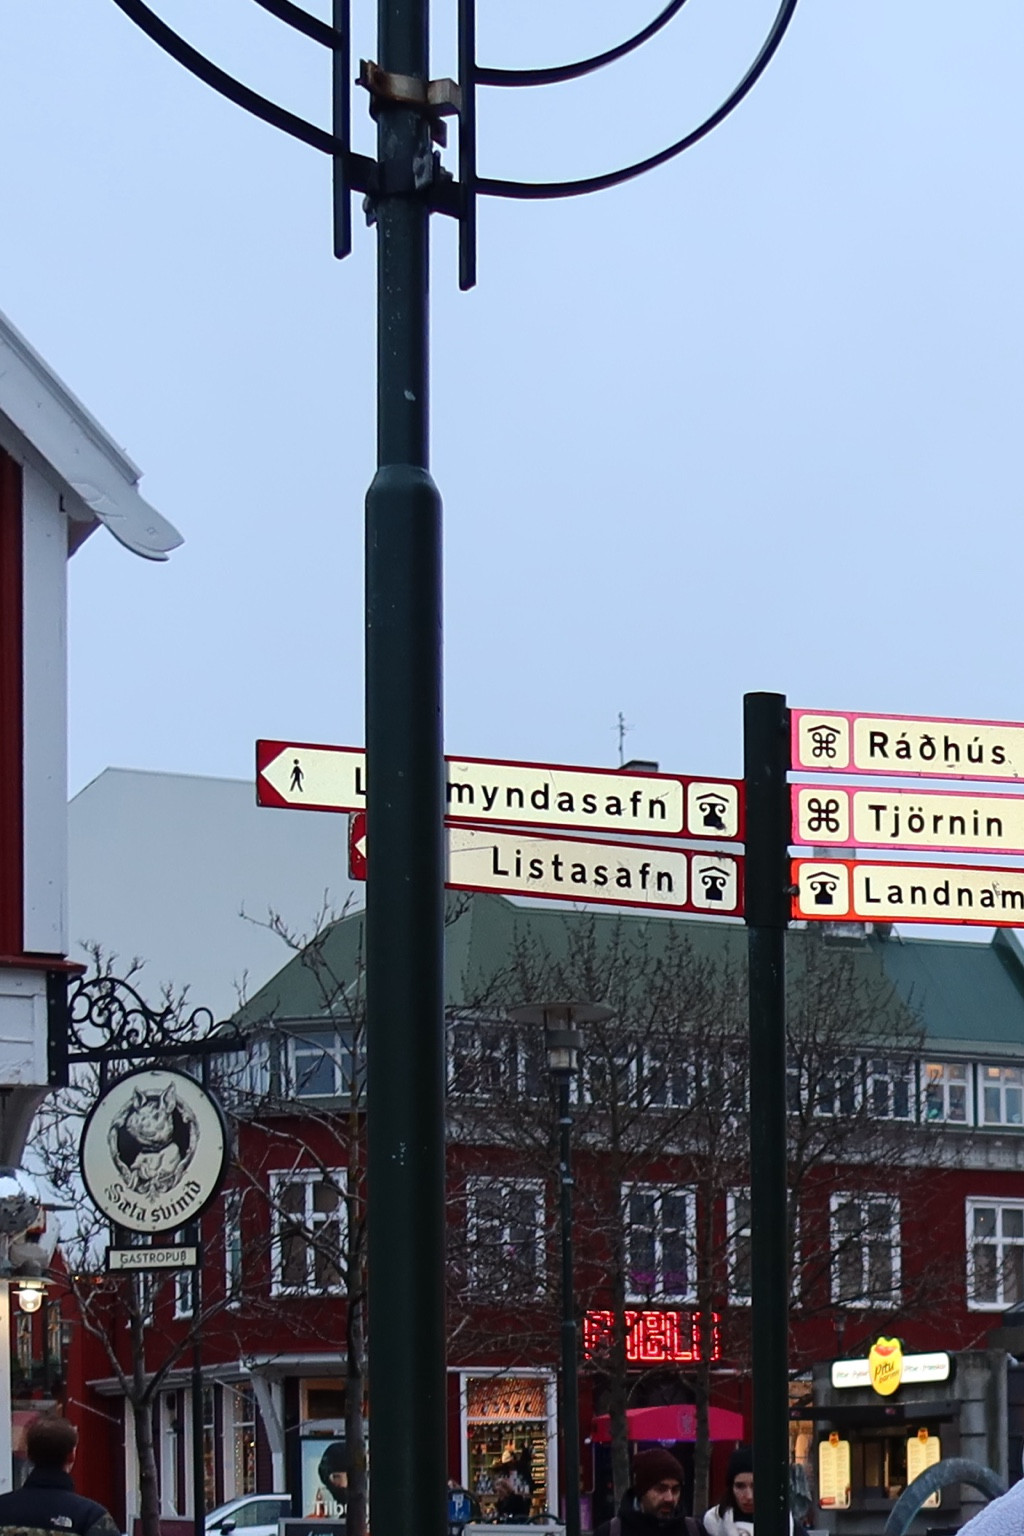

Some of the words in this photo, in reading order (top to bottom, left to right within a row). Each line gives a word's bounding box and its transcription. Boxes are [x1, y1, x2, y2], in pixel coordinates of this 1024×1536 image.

[869, 730, 1007, 765] Ráðhús
[355, 766, 667, 820] Lmyndasafn
[867, 804, 1003, 838] Tjörnin
[491, 845, 674, 893] Listasafn
[120, 1250, 187, 1264] GASTROPUB
